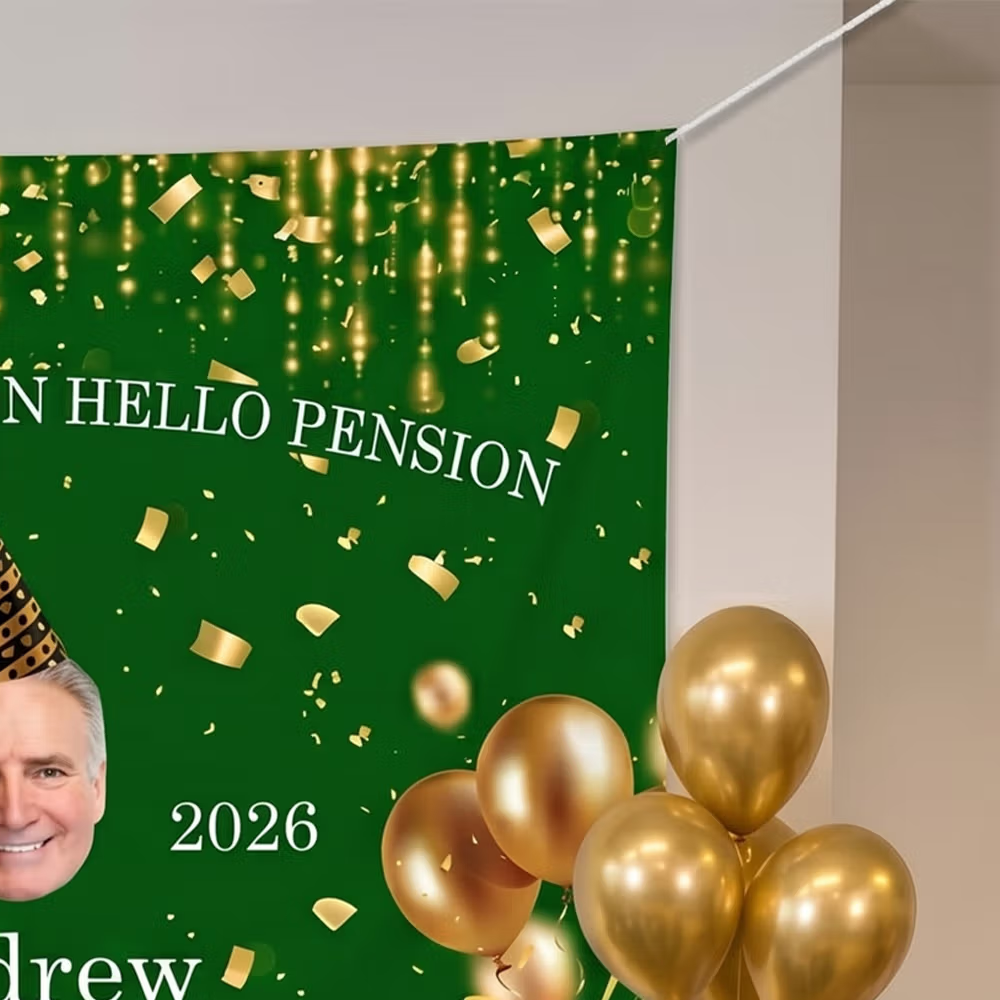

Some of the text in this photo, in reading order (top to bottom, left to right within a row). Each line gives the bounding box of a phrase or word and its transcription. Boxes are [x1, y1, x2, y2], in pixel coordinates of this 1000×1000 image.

[65, 377, 271, 440] HELLO
[289, 398, 561, 506] PENSION
[170, 800, 318, 852] 2026
